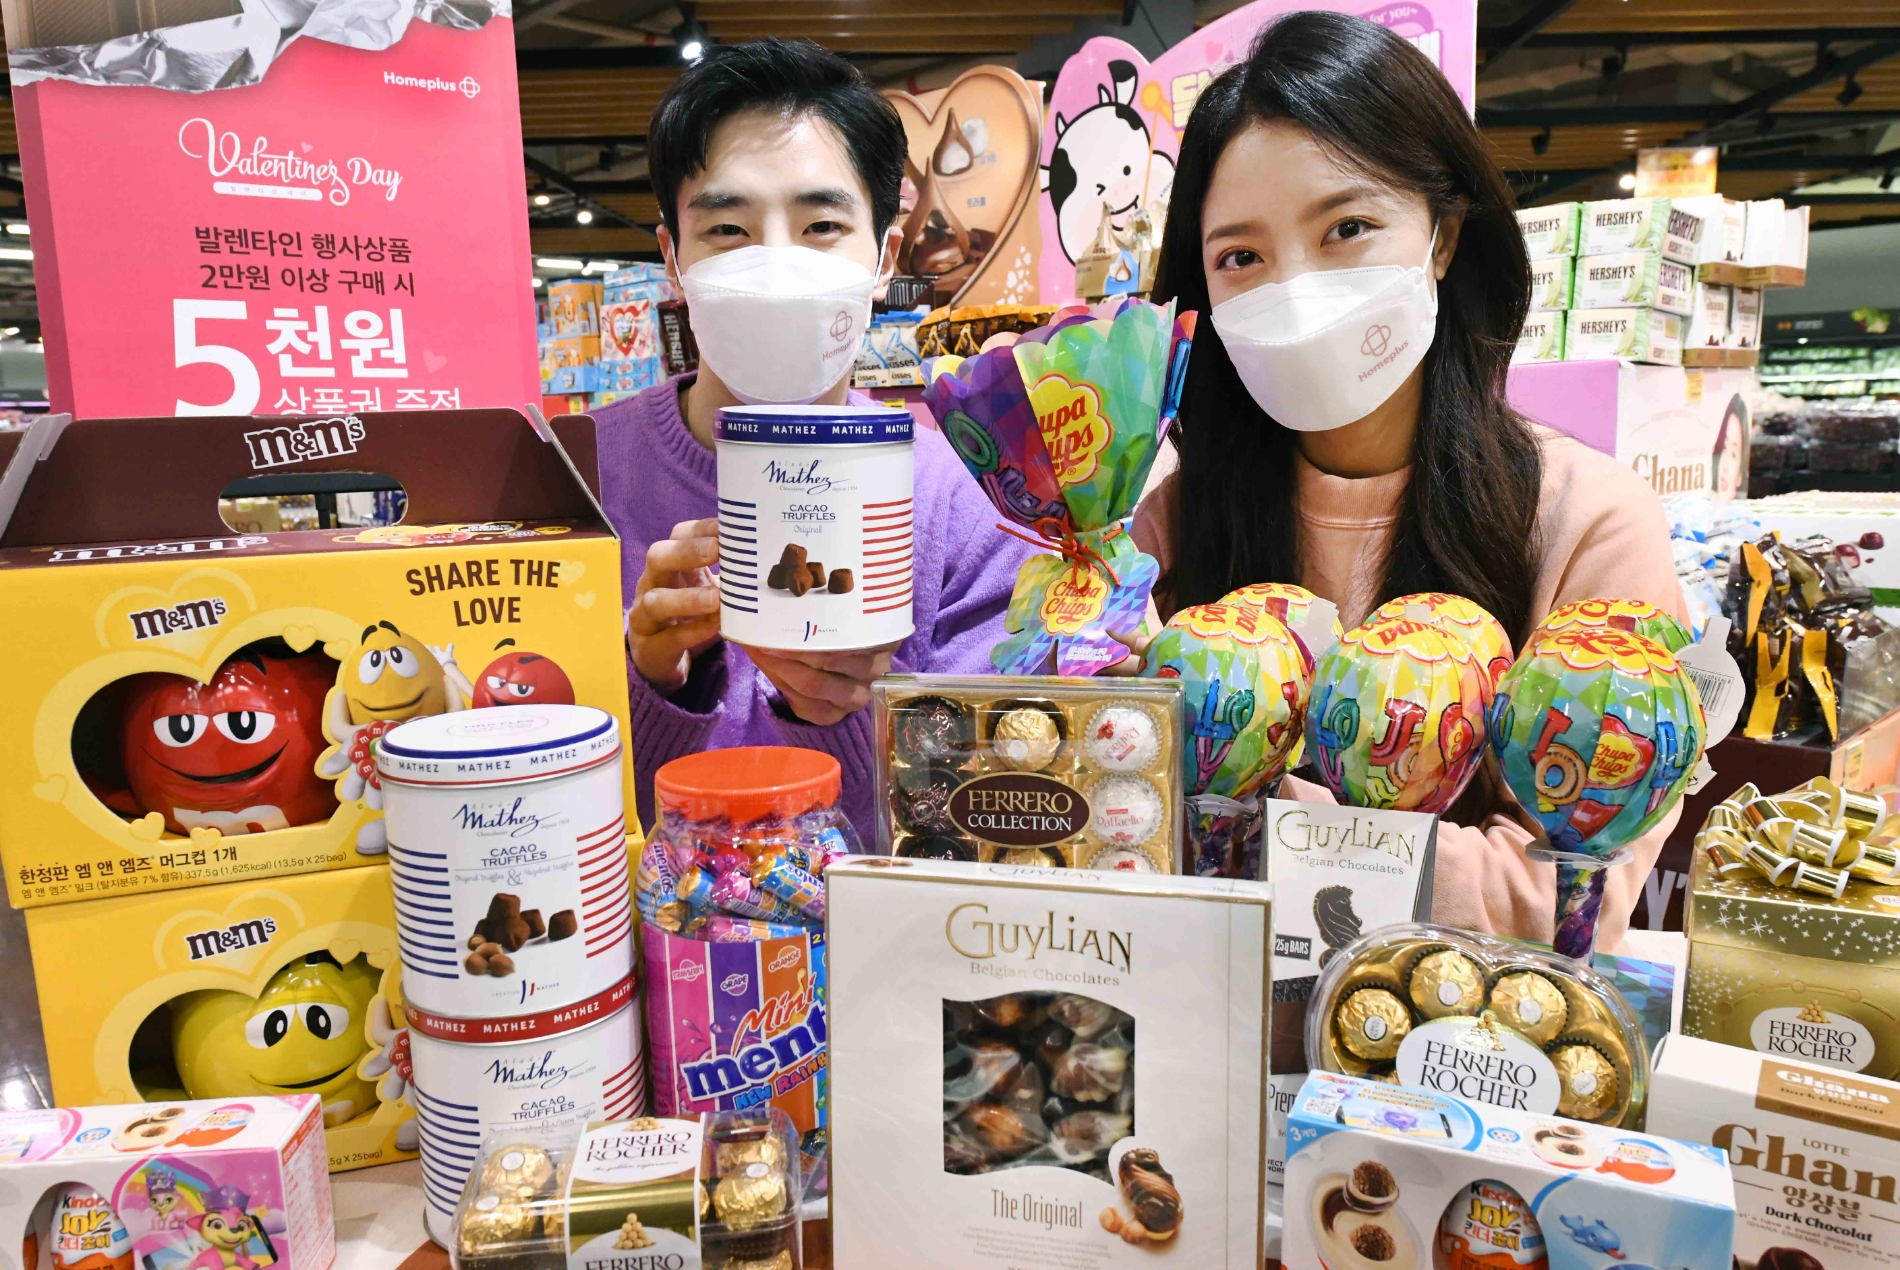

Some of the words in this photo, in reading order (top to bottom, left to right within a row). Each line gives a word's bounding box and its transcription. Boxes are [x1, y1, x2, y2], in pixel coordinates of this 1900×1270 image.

[384, 71, 457, 93] Homeplus
[347, 157, 403, 202] Day
[1596, 211, 1643, 226] HERSHEY'S
[194, 226, 303, 259] 발렌타인
[311, 233, 412, 263] 행사상품
[200, 264, 270, 291] 2만원
[281, 266, 330, 293] 이상
[338, 270, 385, 296] 구매
[394, 272, 415, 297] 시
[1589, 265, 1636, 281] HERSHEY'S
[1581, 320, 1627, 334] HERSHEY'S
[173, 298, 261, 417] 5
[265, 304, 409, 379] 천원
[1358, 340, 1409, 383] Homeplus
[727, 422, 759, 433] MATHEZ
[772, 425, 817, 435] MATHEZ
[832, 425, 873, 435] MATHEZ
[885, 424, 910, 434] MATHEZ
[761, 459, 851, 495] Mathez
[781, 511, 836, 521] TRUFFLES
[789, 504, 828, 513] CACAO
[793, 524, 823, 537] Original
[405, 560, 501, 597] SHARE
[508, 558, 562, 589] THE
[452, 596, 522, 627] LOVE
[1045, 595, 1094, 620] Chups
[398, 762, 440, 773] MATHEZ
[457, 760, 512, 772] MATHEZ
[530, 749, 577, 765] MATHEZ
[590, 734, 616, 752] MATHEZ
[1596, 742, 1636, 761] Chupa
[1592, 755, 1630, 775] Chups
[967, 789, 1073, 814] FERRERO
[451, 797, 561, 838] Mathez
[967, 813, 1073, 832] COLLECTION
[481, 851, 548, 867] TRUFFLES
[490, 843, 537, 858] CACAO
[19, 863, 70, 886] 한정판
[75, 863, 92, 879] 엠
[97, 861, 114, 877] 앤
[160, 849, 207, 869] 머그컵
[212, 846, 238, 862] 1개
[75, 883, 95, 893] 밀크
[185, 868, 219, 880] 337.5g
[314, 851, 347, 864] 25bag)
[507, 868, 524, 887] &
[1292, 854, 1335, 868] Belgian
[1338, 859, 1405, 876] Chocolates
[1276, 938, 1289, 954] 25g
[1289, 939, 1309, 955] BARS
[672, 963, 704, 981] STRAWBERRY
[769, 950, 801, 972] ORANGE
[721, 975, 749, 990] GRAPE
[970, 962, 1028, 980] Belgian
[1033, 968, 1120, 987] Chocolates
[426, 1018, 466, 1034] MATHEZ
[483, 1019, 536, 1034] MATHEZ
[553, 1002, 600, 1024] MATHEZ
[732, 973, 816, 1056] Mini
[1768, 1020, 1857, 1048] FERRERO
[683, 1004, 826, 1099] ment
[1768, 1036, 1855, 1064] ROCHER
[483, 1050, 588, 1090] Mathez
[1425, 1039, 1537, 1088] FERRERO
[735, 1086, 772, 1110] NEW
[1420, 1064, 1529, 1111] ROCHER
[511, 1101, 575, 1121] TRUFFLES
[521, 1095, 566, 1110] CACAO
[586, 1143, 689, 1162] ROCHER
[589, 1132, 692, 1150] FERRERO
[1803, 1138, 1851, 1157] LOTTE
[352, 1149, 383, 1163] 25bag)
[1712, 1124, 1900, 1205] Ghan
[992, 1189, 1019, 1220] The
[1023, 1193, 1083, 1231] Original
[1467, 1198, 1521, 1229] JOY
[1783, 1184, 1864, 1222] 앙상블
[59, 1210, 110, 1236] JOY
[1746, 1221, 1778, 1233] GHANA
[1781, 1230, 1829, 1248] ENSEMBLE
[1766, 1206, 1802, 1224] Dark
[1805, 1216, 1873, 1243] Chocolat
[58, 1236, 79, 1251] 킨더
[81, 1233, 111, 1250] 조이
[1464, 1220, 1491, 1243] 킨더
[1491, 1230, 1520, 1252] 조이
